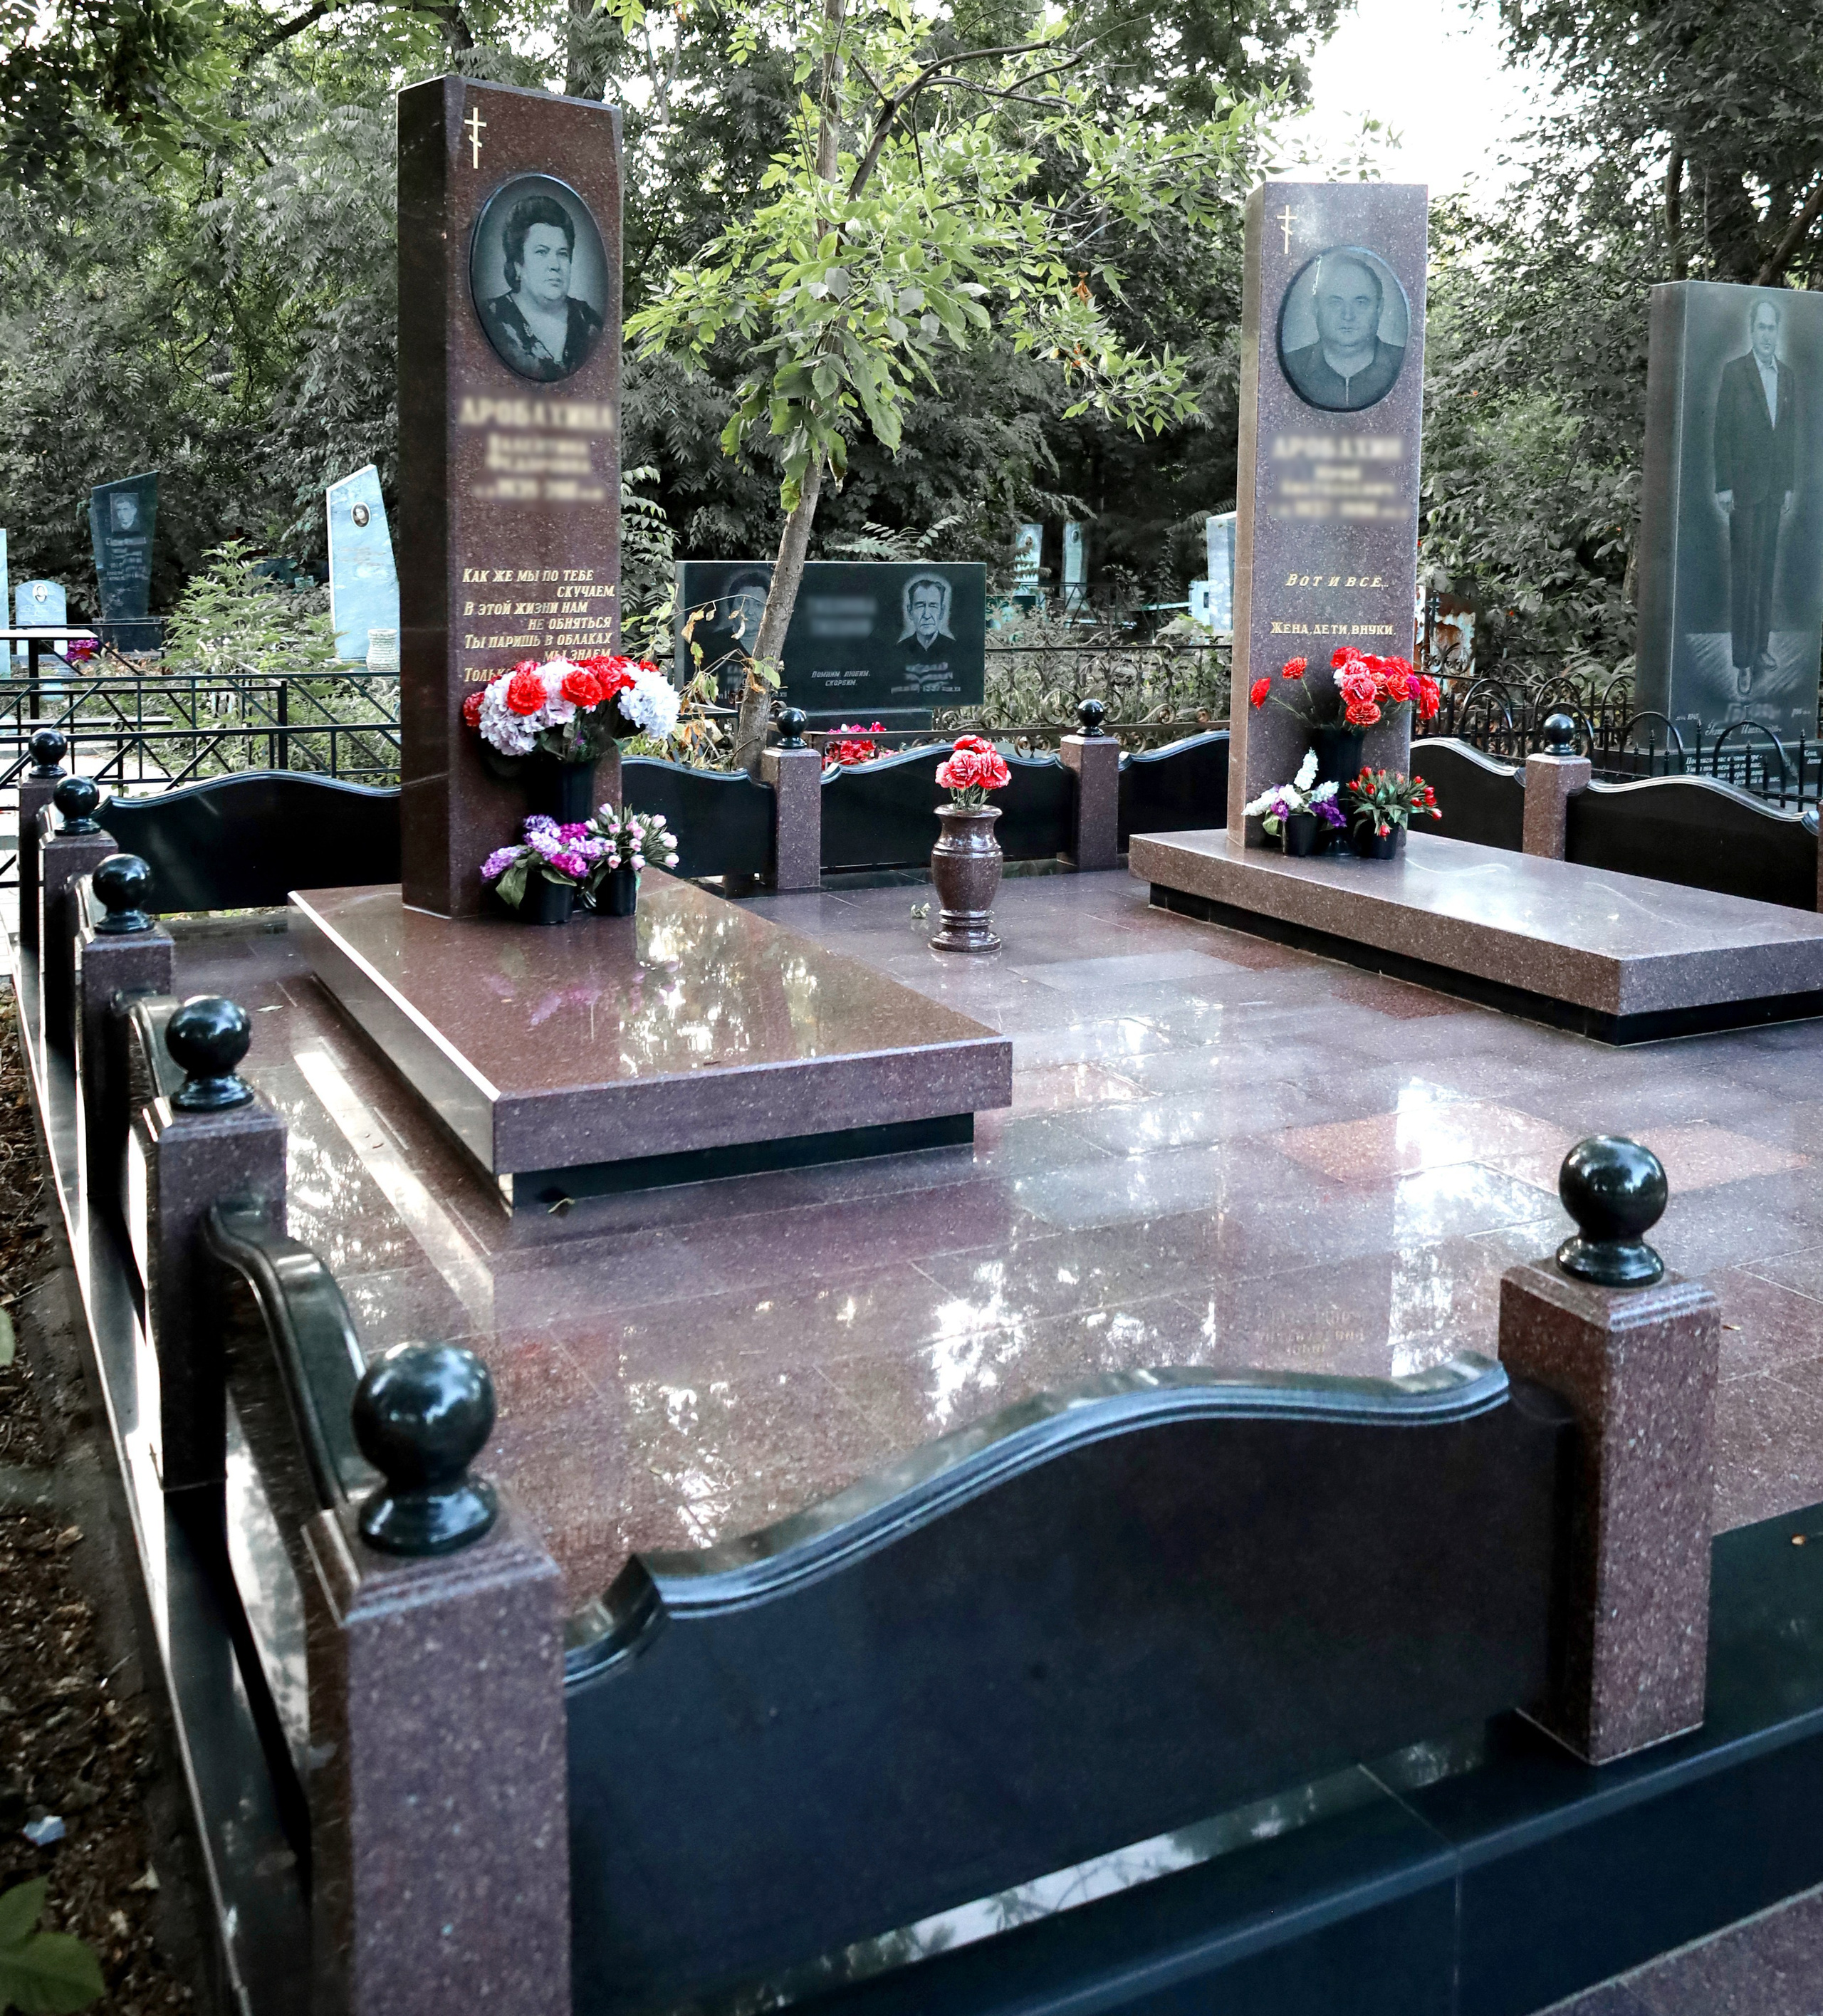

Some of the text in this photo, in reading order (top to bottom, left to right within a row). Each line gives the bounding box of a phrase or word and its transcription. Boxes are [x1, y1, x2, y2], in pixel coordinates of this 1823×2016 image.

[492, 569, 514, 583] ЖЕ
[517, 570, 539, 582] МЫ
[542, 570, 559, 582] ПО
[563, 570, 594, 582] ТЕБЕ
[463, 600, 588, 616] В ЭТОЙ ЖИЗНИ НАМ
[528, 617, 612, 631] НЕ ОБНЯТЬСЯ
[464, 633, 612, 649] ТЫ ПАРИШЬ В ОБЛАКАХ
